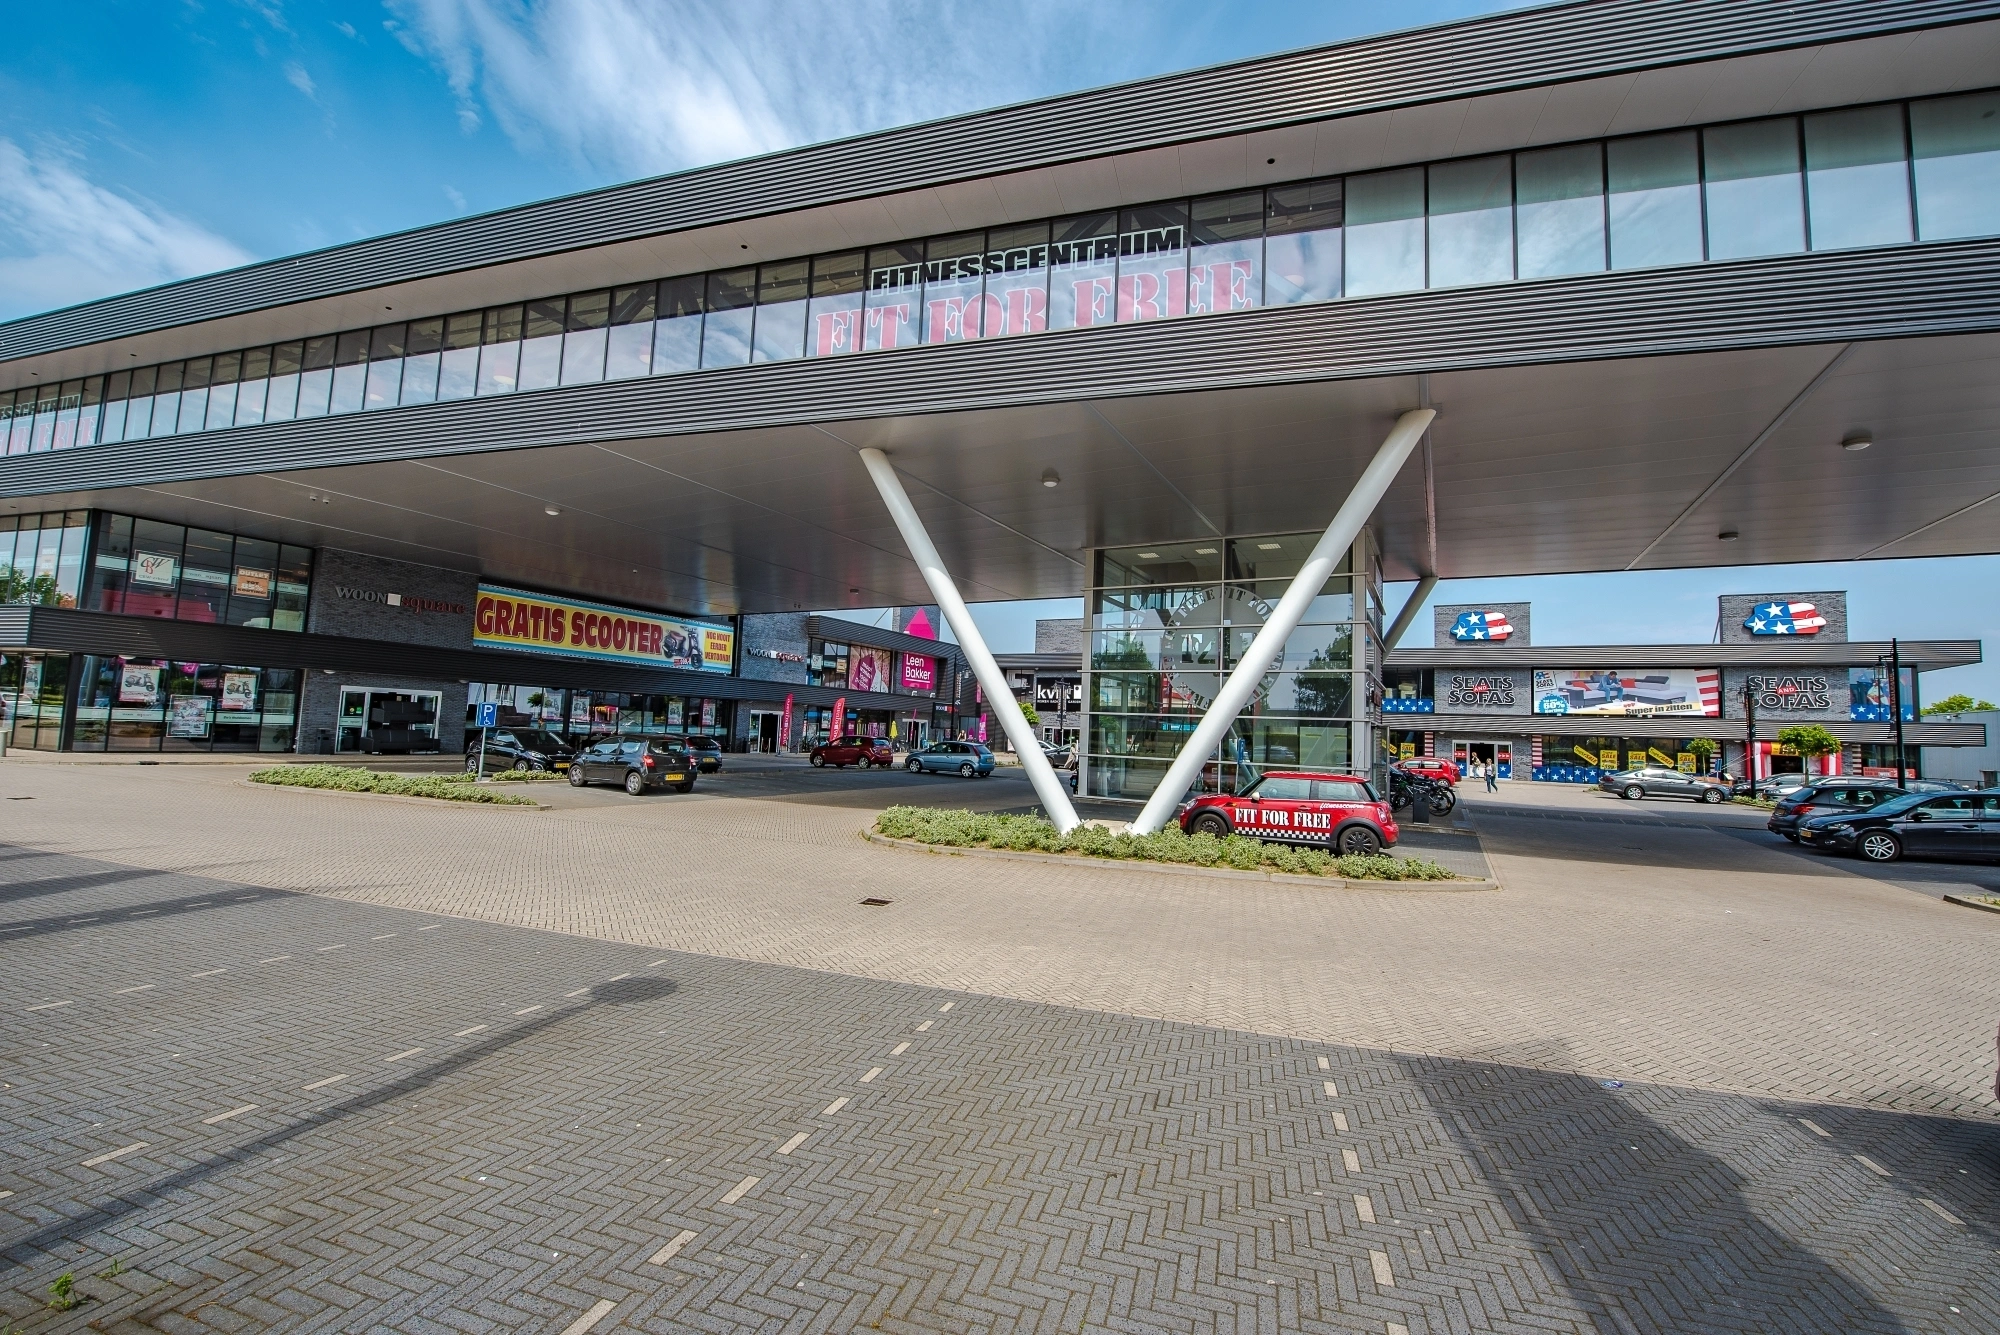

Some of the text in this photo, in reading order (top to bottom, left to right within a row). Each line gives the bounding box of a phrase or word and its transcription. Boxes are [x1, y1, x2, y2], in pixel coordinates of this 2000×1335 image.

[870, 225, 1184, 298] FITNESSCENTRUM
[816, 259, 1252, 357] FIT FOR FREE
[38, 416, 98, 451] FREE
[239, 569, 270, 579] OUTLET
[241, 582, 264, 591] 85%
[335, 586, 467, 615] WOON square
[1219, 587, 1247, 601] FIT
[1178, 588, 1215, 618] FREE
[475, 596, 664, 656] GRATIS SCOOTER
[706, 631, 717, 640] NOG
[710, 642, 727, 651] EERDER
[906, 654, 924, 667] Leen
[905, 667, 931, 681] Bakker
[1452, 676, 1513, 690] SEATS
[1748, 675, 1829, 692] SEATS
[1448, 690, 1516, 705] SOFAS
[484, 705, 494, 717] P
[1543, 701, 1566, 709] 60%
[1625, 706, 1653, 715] Super
[1665, 703, 1693, 711] zitten
[1235, 808, 1331, 829] FIT FOR FREE
